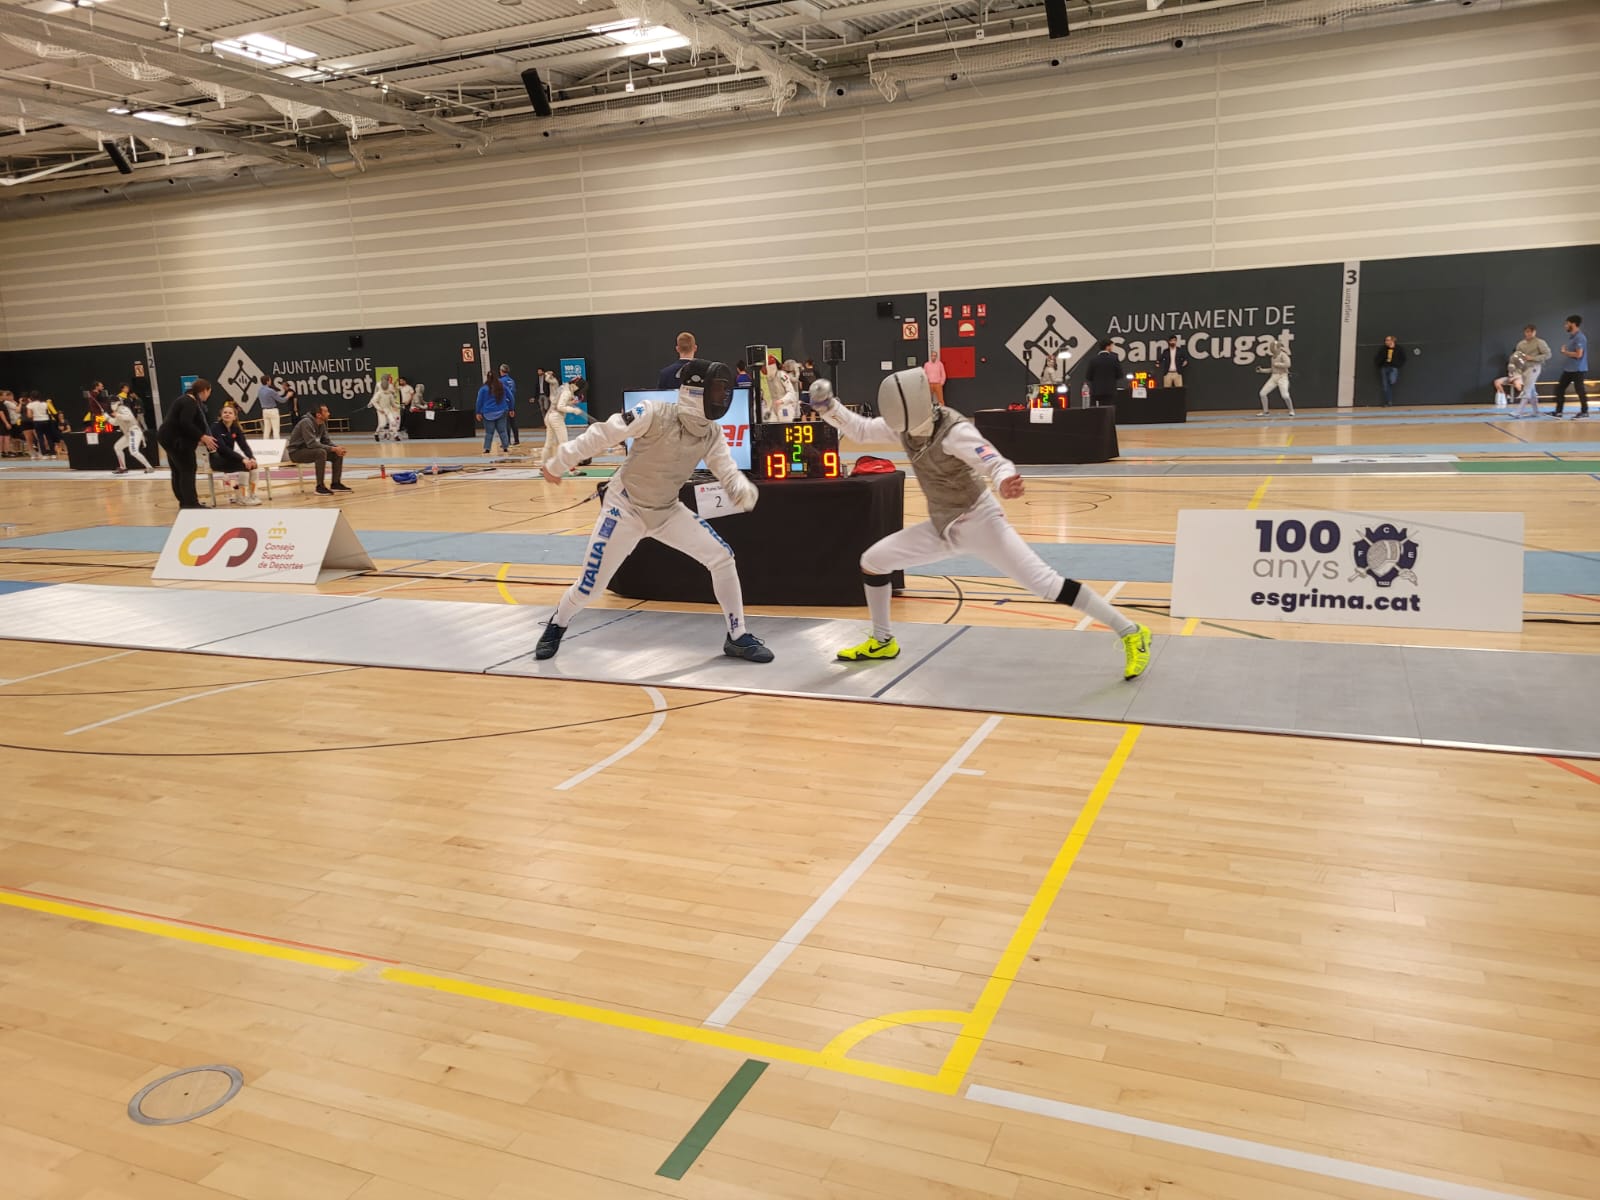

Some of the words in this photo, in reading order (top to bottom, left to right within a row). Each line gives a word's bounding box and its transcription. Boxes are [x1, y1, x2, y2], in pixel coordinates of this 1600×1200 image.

[1345, 269, 1357, 285] 3
[929, 298, 938, 312] 5
[928, 314, 938, 327] 6
[1107, 307, 1259, 333] AJUNTAMENT
[1265, 305, 1295, 325] DE
[479, 328, 486, 339] 3
[481, 340, 488, 352] 4
[148, 358, 155, 368] 2
[273, 358, 352, 375] AJUNTAMENT
[355, 357, 372, 372] DE
[1042, 394, 1049, 403] 2
[785, 425, 813, 444] 1:39
[792, 444, 802, 462] 2
[767, 453, 786, 479] 13
[823, 452, 838, 478] 9
[714, 495, 724, 508] 2
[1256, 519, 1341, 553] 100
[1383, 526, 1391, 534] C
[264, 542, 295, 553] Consejo
[1358, 550, 1364, 558] F
[261, 552, 294, 560] Superior
[1407, 551, 1415, 559] E
[257, 561, 268, 569] de
[269, 561, 304, 571] Deportes
[577, 541, 607, 596] ITALIA
[1252, 557, 1339, 587] anys
[1251, 588, 1421, 613] esgrima.cat
